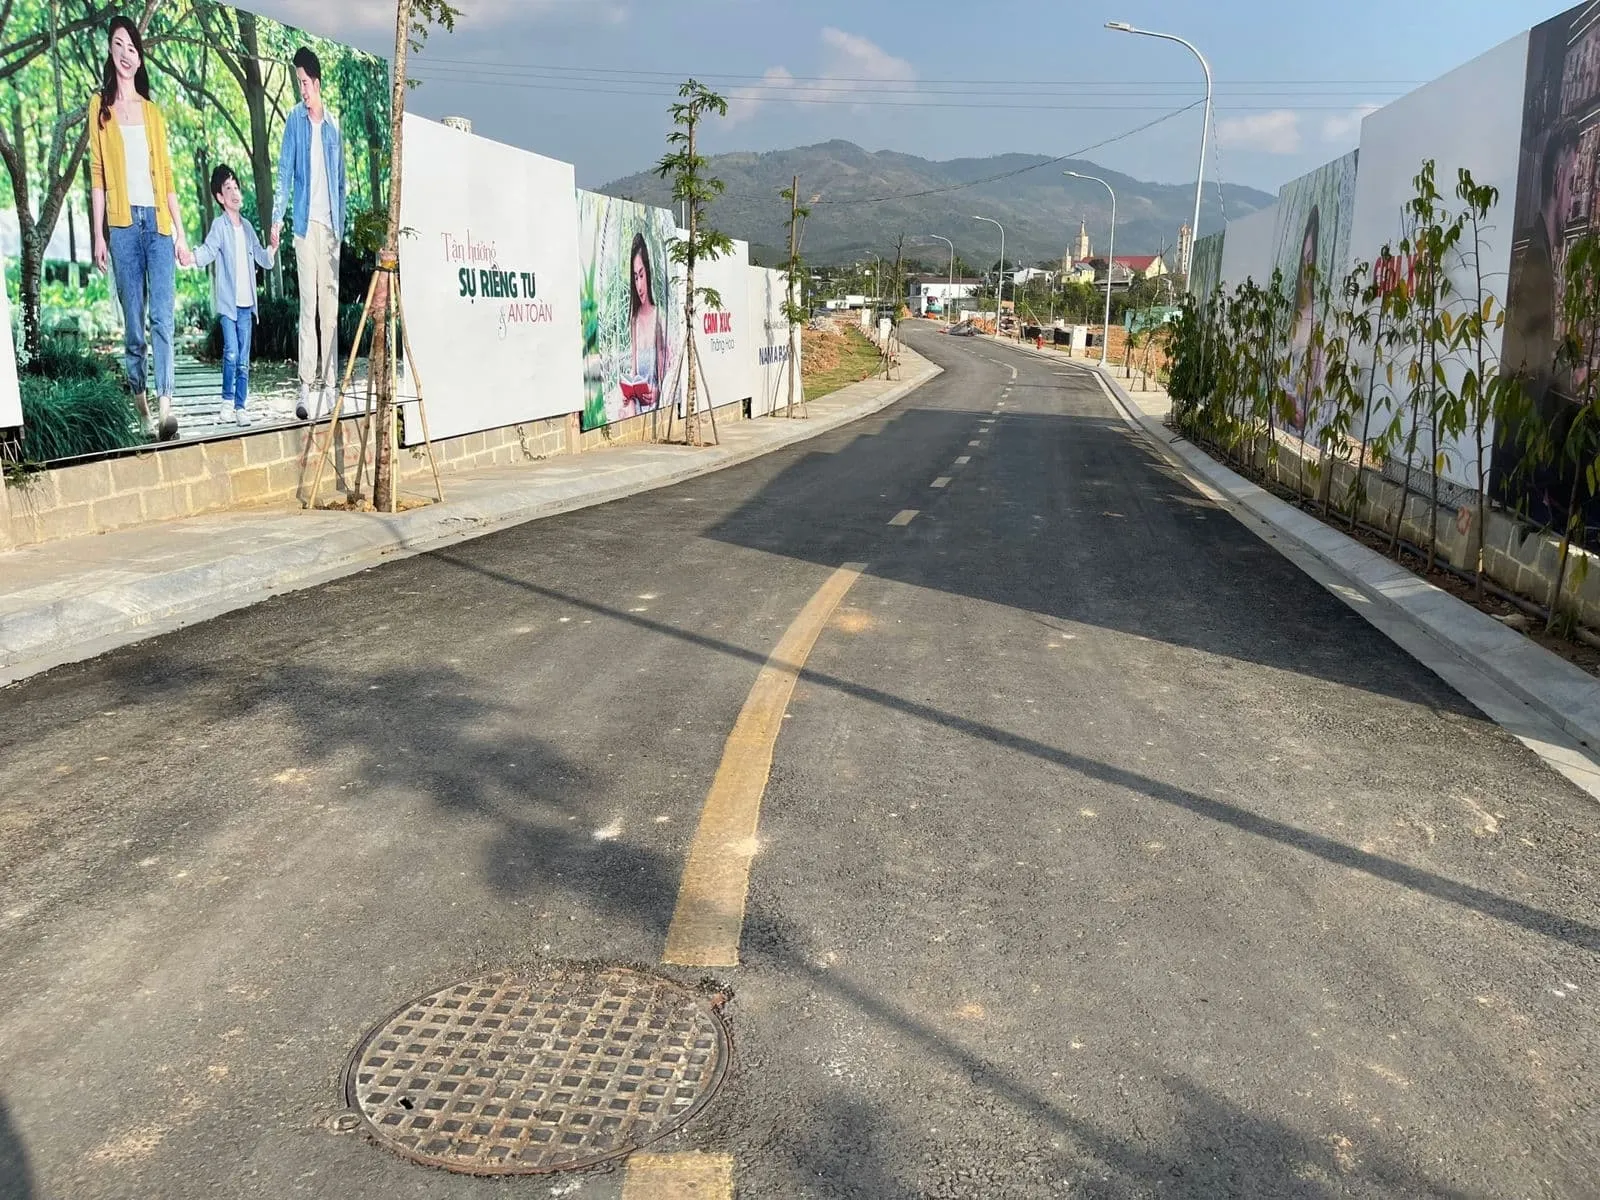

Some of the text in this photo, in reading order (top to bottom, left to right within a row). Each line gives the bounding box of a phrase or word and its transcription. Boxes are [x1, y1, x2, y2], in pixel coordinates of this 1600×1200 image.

[441, 232, 465, 263] Tận
[458, 264, 537, 304] SỰ RIÊNG TƯ
[508, 304, 523, 323] AN
[525, 299, 553, 324] TOÀN
